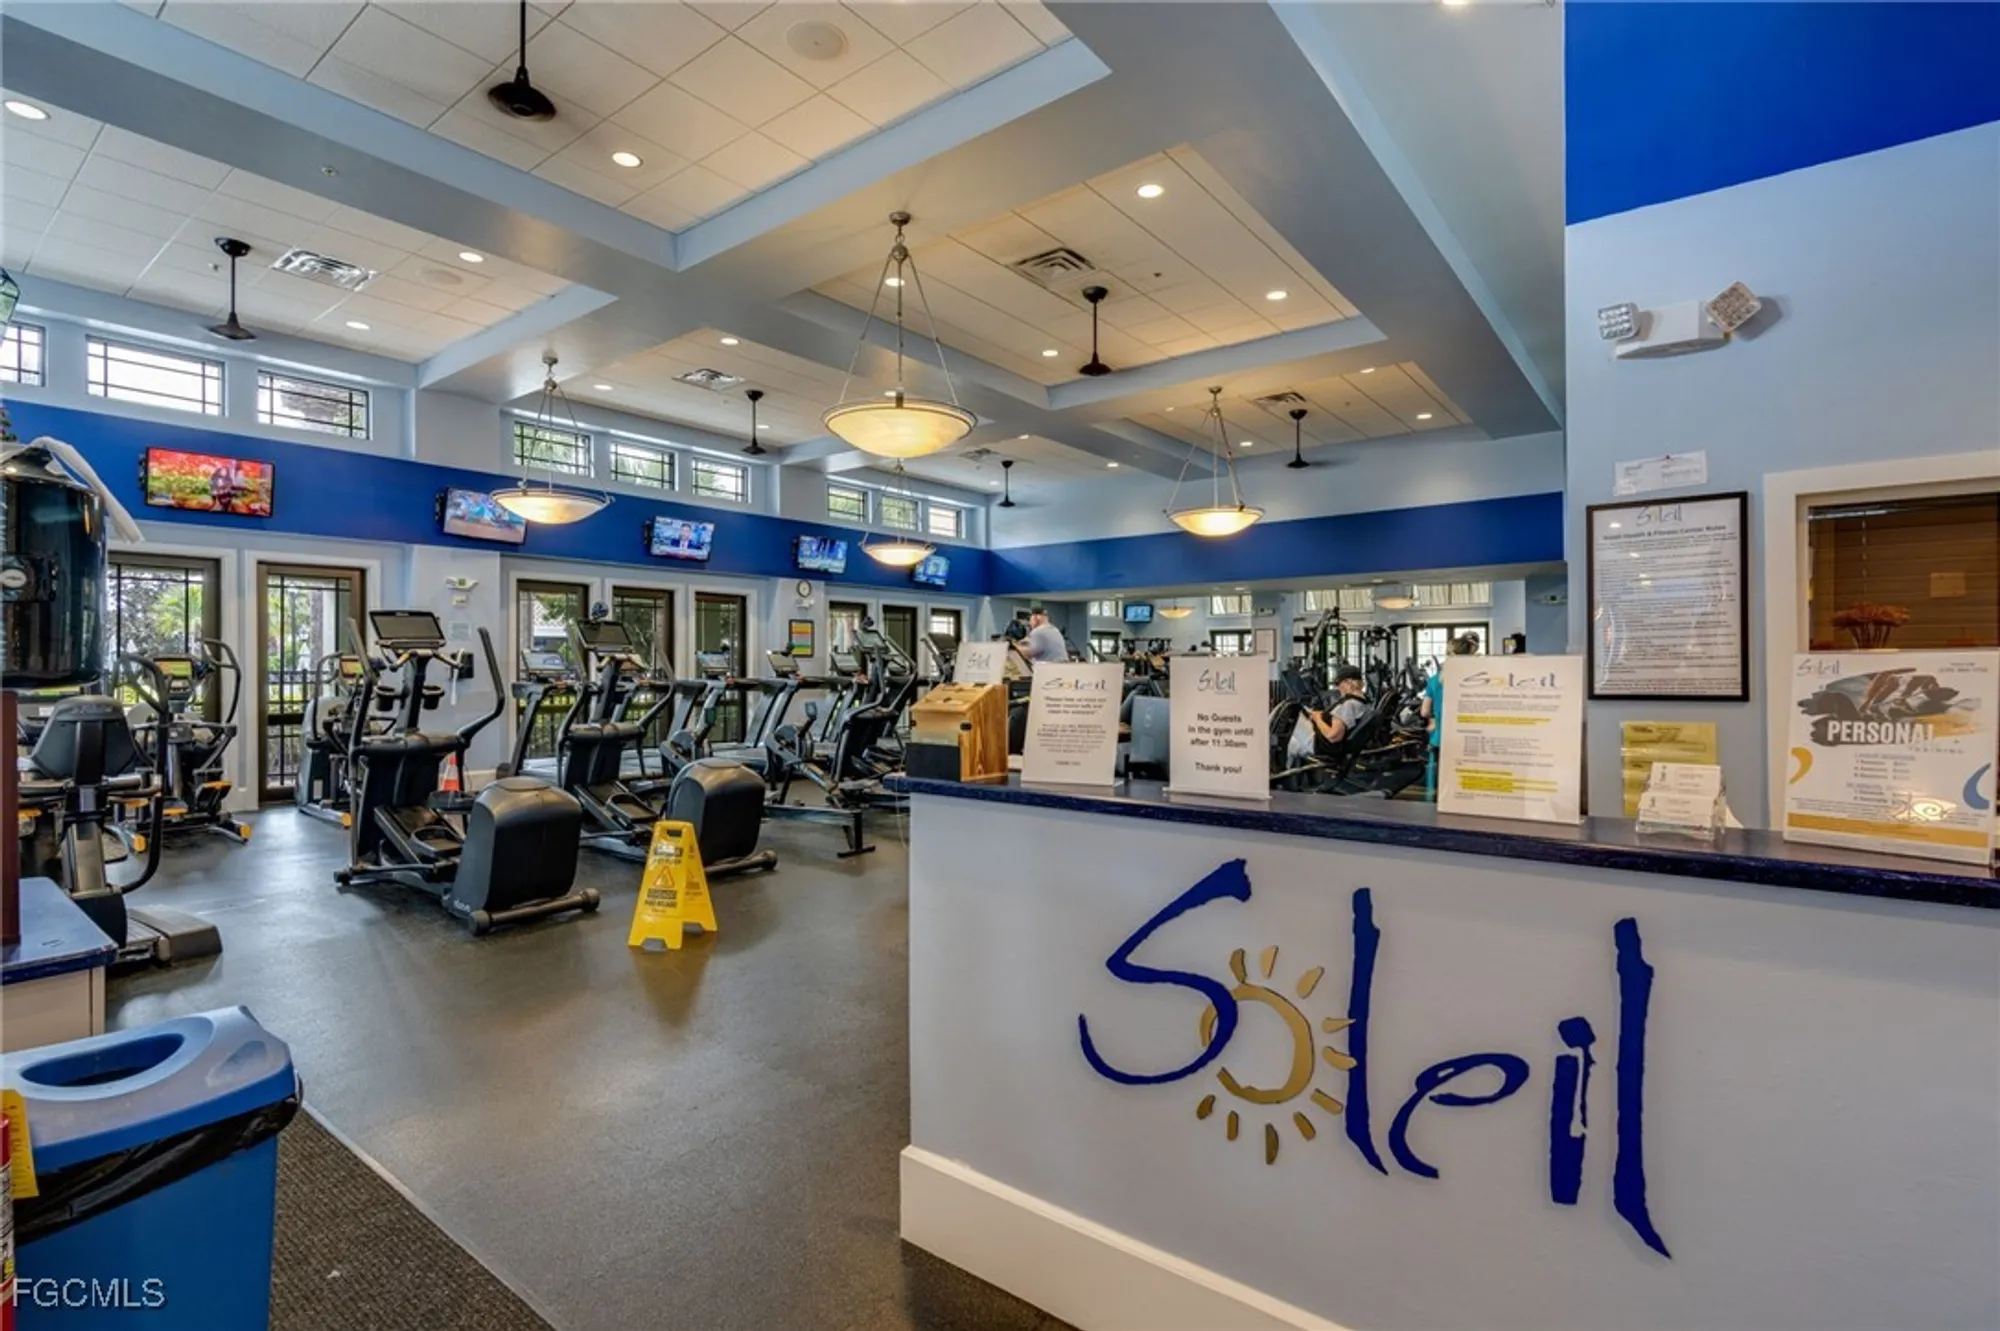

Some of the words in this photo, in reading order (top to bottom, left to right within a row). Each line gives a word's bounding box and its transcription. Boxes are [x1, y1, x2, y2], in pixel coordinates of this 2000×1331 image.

[1197, 713, 1209, 722] No
[1211, 713, 1242, 723] Guests
[1188, 725, 1196, 733] in
[1197, 725, 1211, 734] the
[1213, 727, 1232, 737] gym
[1234, 727, 1254, 736] until
[1190, 738, 1209, 746] after
[1195, 761, 1220, 771] Thank
[1223, 765, 1242, 774] you!
[1078, 859, 1671, 1260] Soleil
